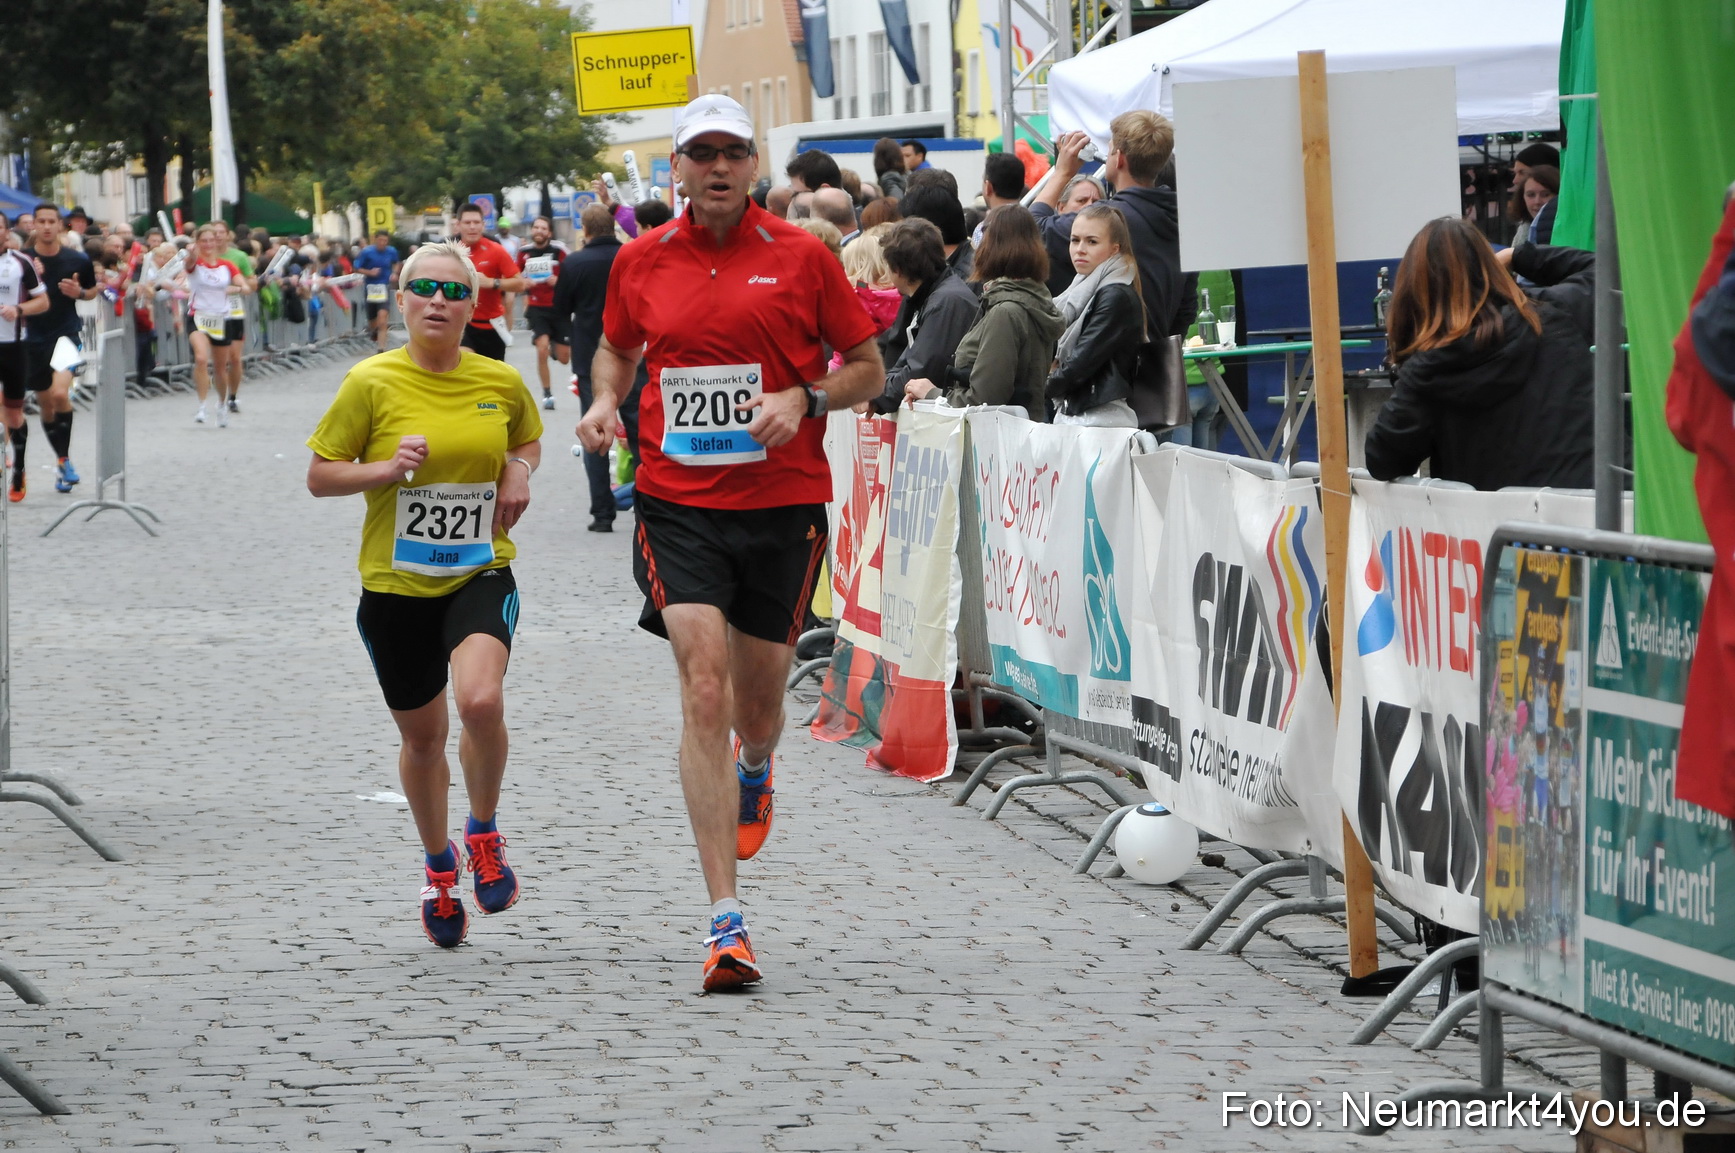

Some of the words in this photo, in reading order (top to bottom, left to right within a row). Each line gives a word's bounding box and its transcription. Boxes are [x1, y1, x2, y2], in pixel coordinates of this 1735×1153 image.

[583, 52, 686, 72] Schnupper-
[620, 73, 652, 90] lauf
[375, 208, 387, 225] D
[662, 377, 691, 387] PARTL
[693, 375, 742, 386] Neumarkt
[672, 389, 753, 426] 2208
[691, 437, 733, 451] Stefan
[399, 488, 434, 500] PARTL
[437, 490, 480, 501] Neumarkt
[406, 502, 482, 540] 2321
[429, 549, 460, 563] Jana
[1527, 602, 1559, 649] erdgas
[1594, 732, 1644, 808] Mehr
[1592, 826, 1623, 897] für
[1625, 835, 1650, 907] Ihr
[1655, 846, 1716, 926] Event!
[1591, 959, 1618, 1005] Miet
[1620, 968, 1630, 1008] &
[1632, 972, 1671, 1023] Service
[1674, 986, 1703, 1033] Line:
